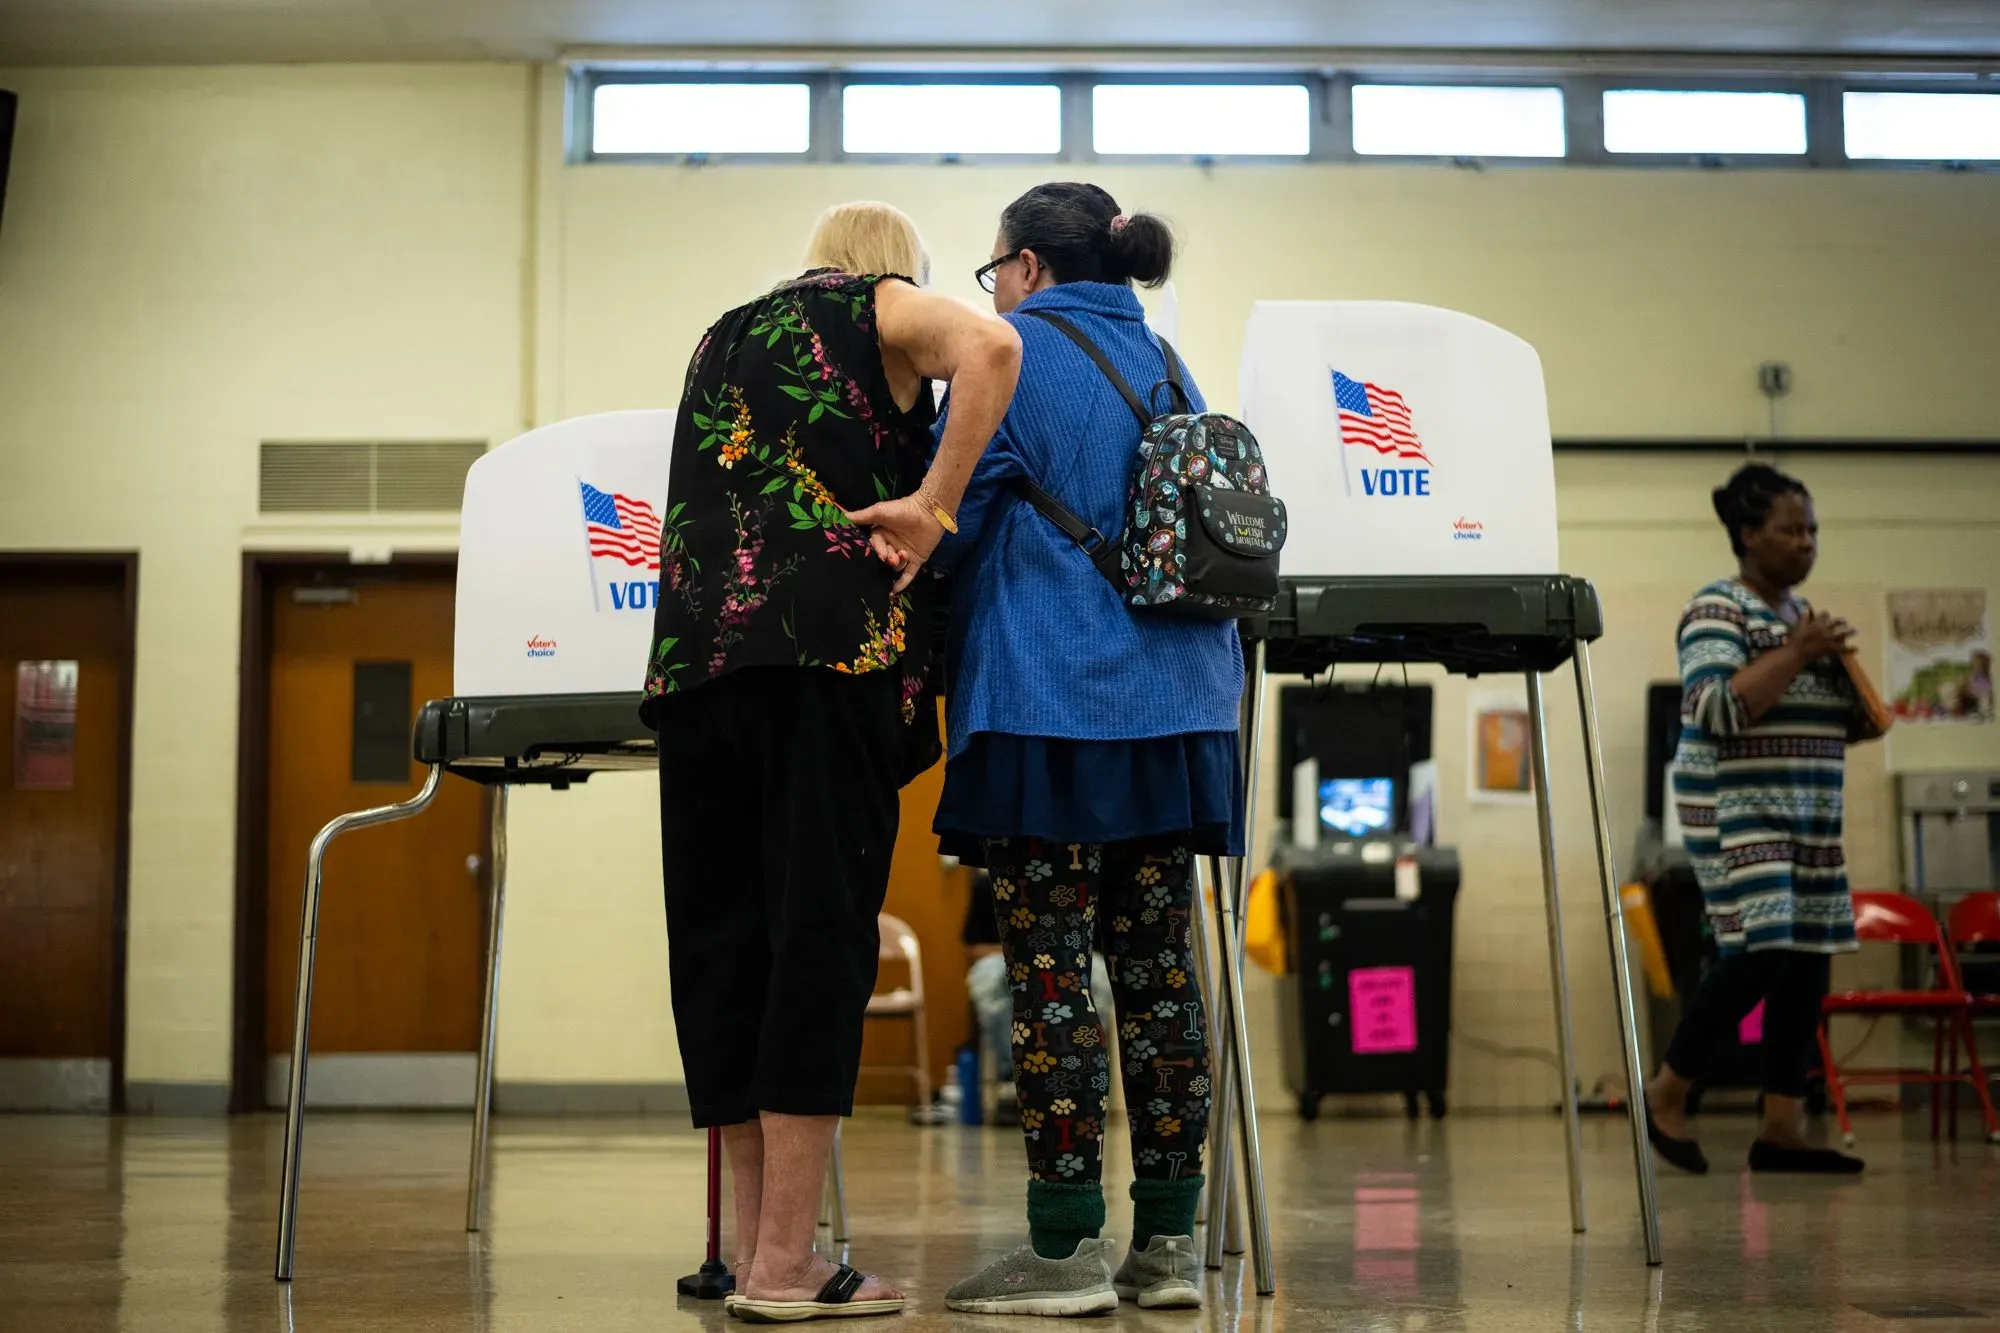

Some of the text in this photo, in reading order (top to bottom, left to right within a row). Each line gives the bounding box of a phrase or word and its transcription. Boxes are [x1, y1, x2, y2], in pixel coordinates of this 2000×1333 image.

[1361, 469, 1430, 496] VOTE
[1226, 510, 1266, 528] WELCOME
[1453, 516, 1483, 529] Voter's
[1236, 536, 1265, 548] MORTALS
[1453, 532, 1481, 540] choice
[610, 581, 659, 609] VOT
[527, 634, 557, 648] Voter's
[527, 648, 555, 657] choice
